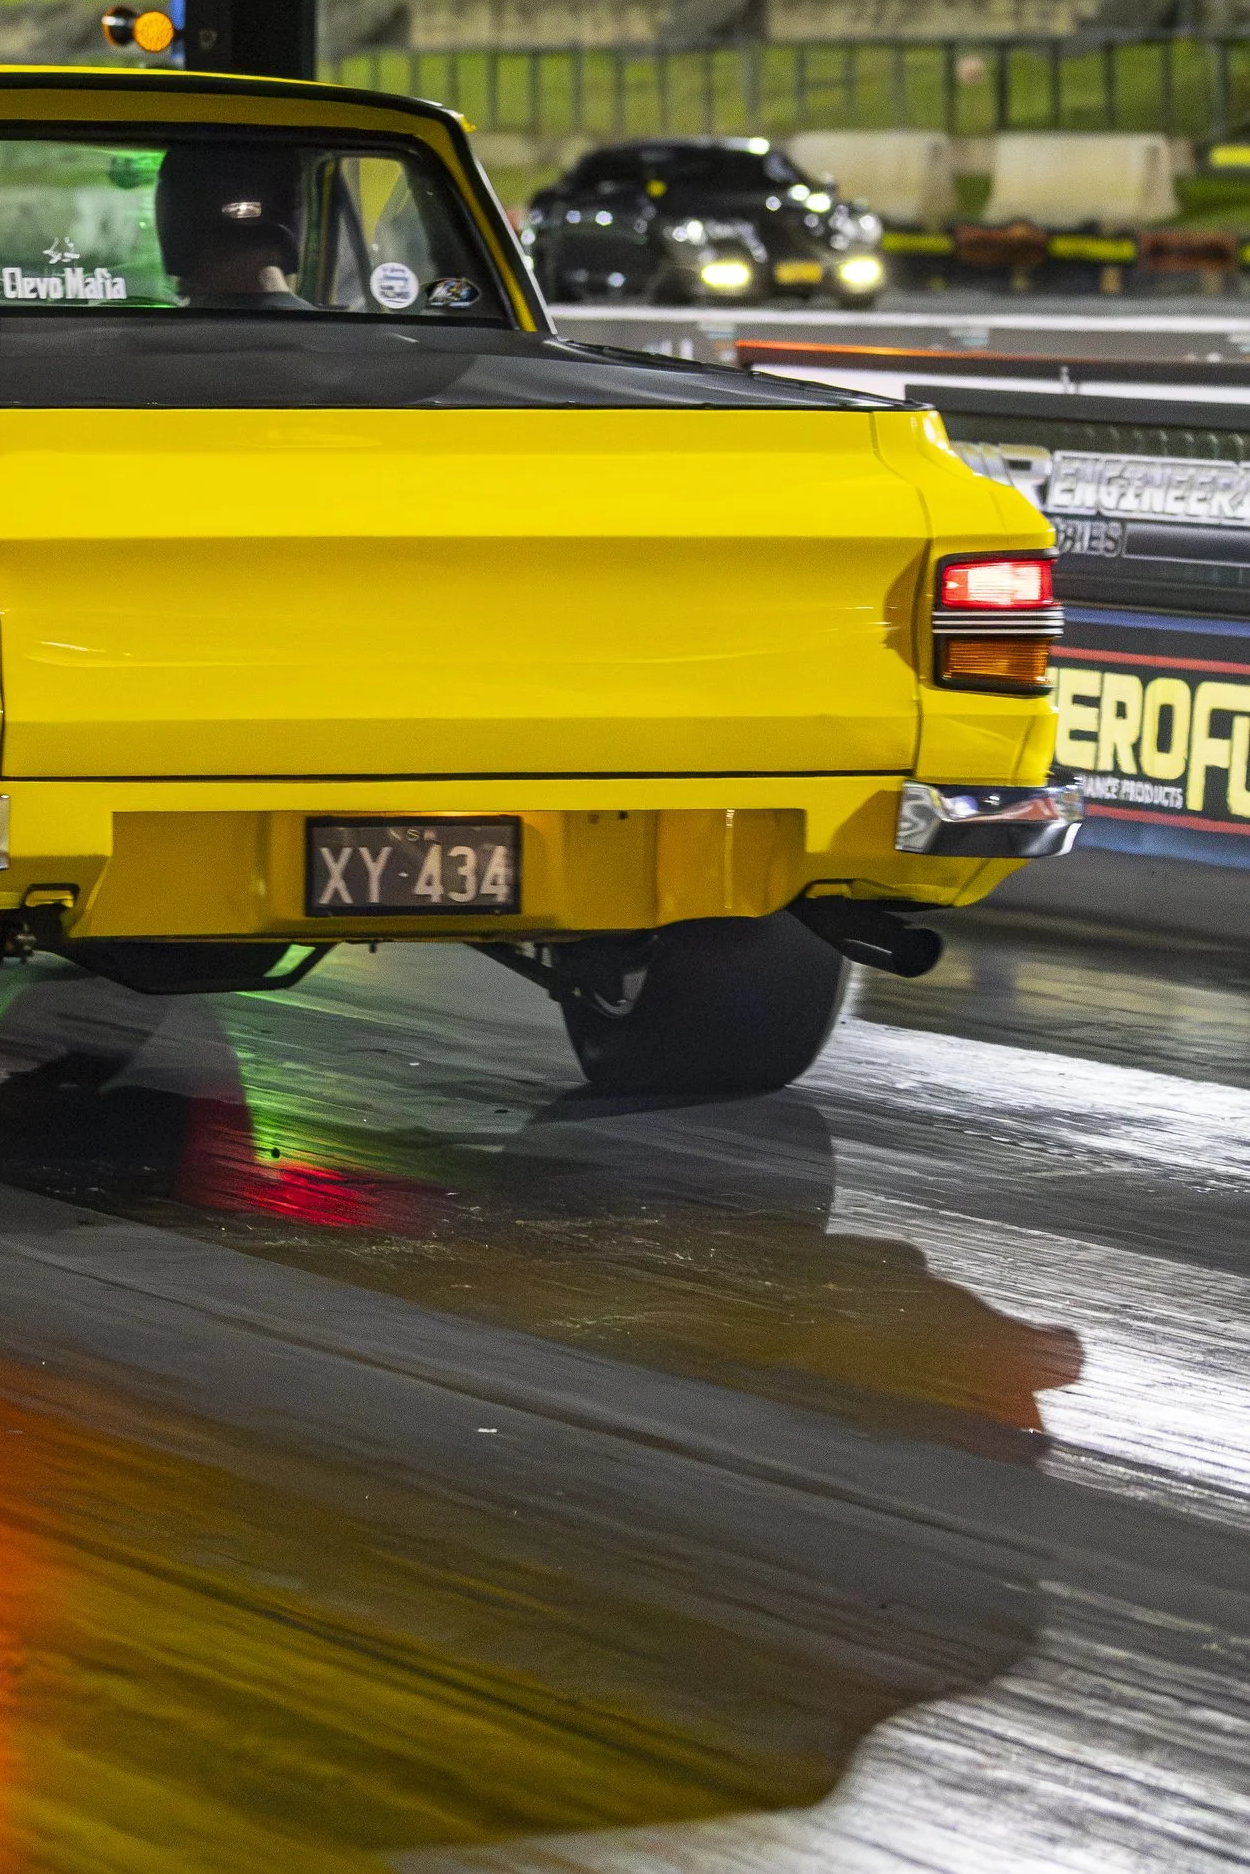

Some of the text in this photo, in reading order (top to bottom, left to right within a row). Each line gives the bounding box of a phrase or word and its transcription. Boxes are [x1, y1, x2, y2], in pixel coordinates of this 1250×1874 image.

[65, 267, 128, 299] Mafia
[1047, 666, 1250, 818] EROFL
[1120, 778, 1185, 811] PRODUCTS
